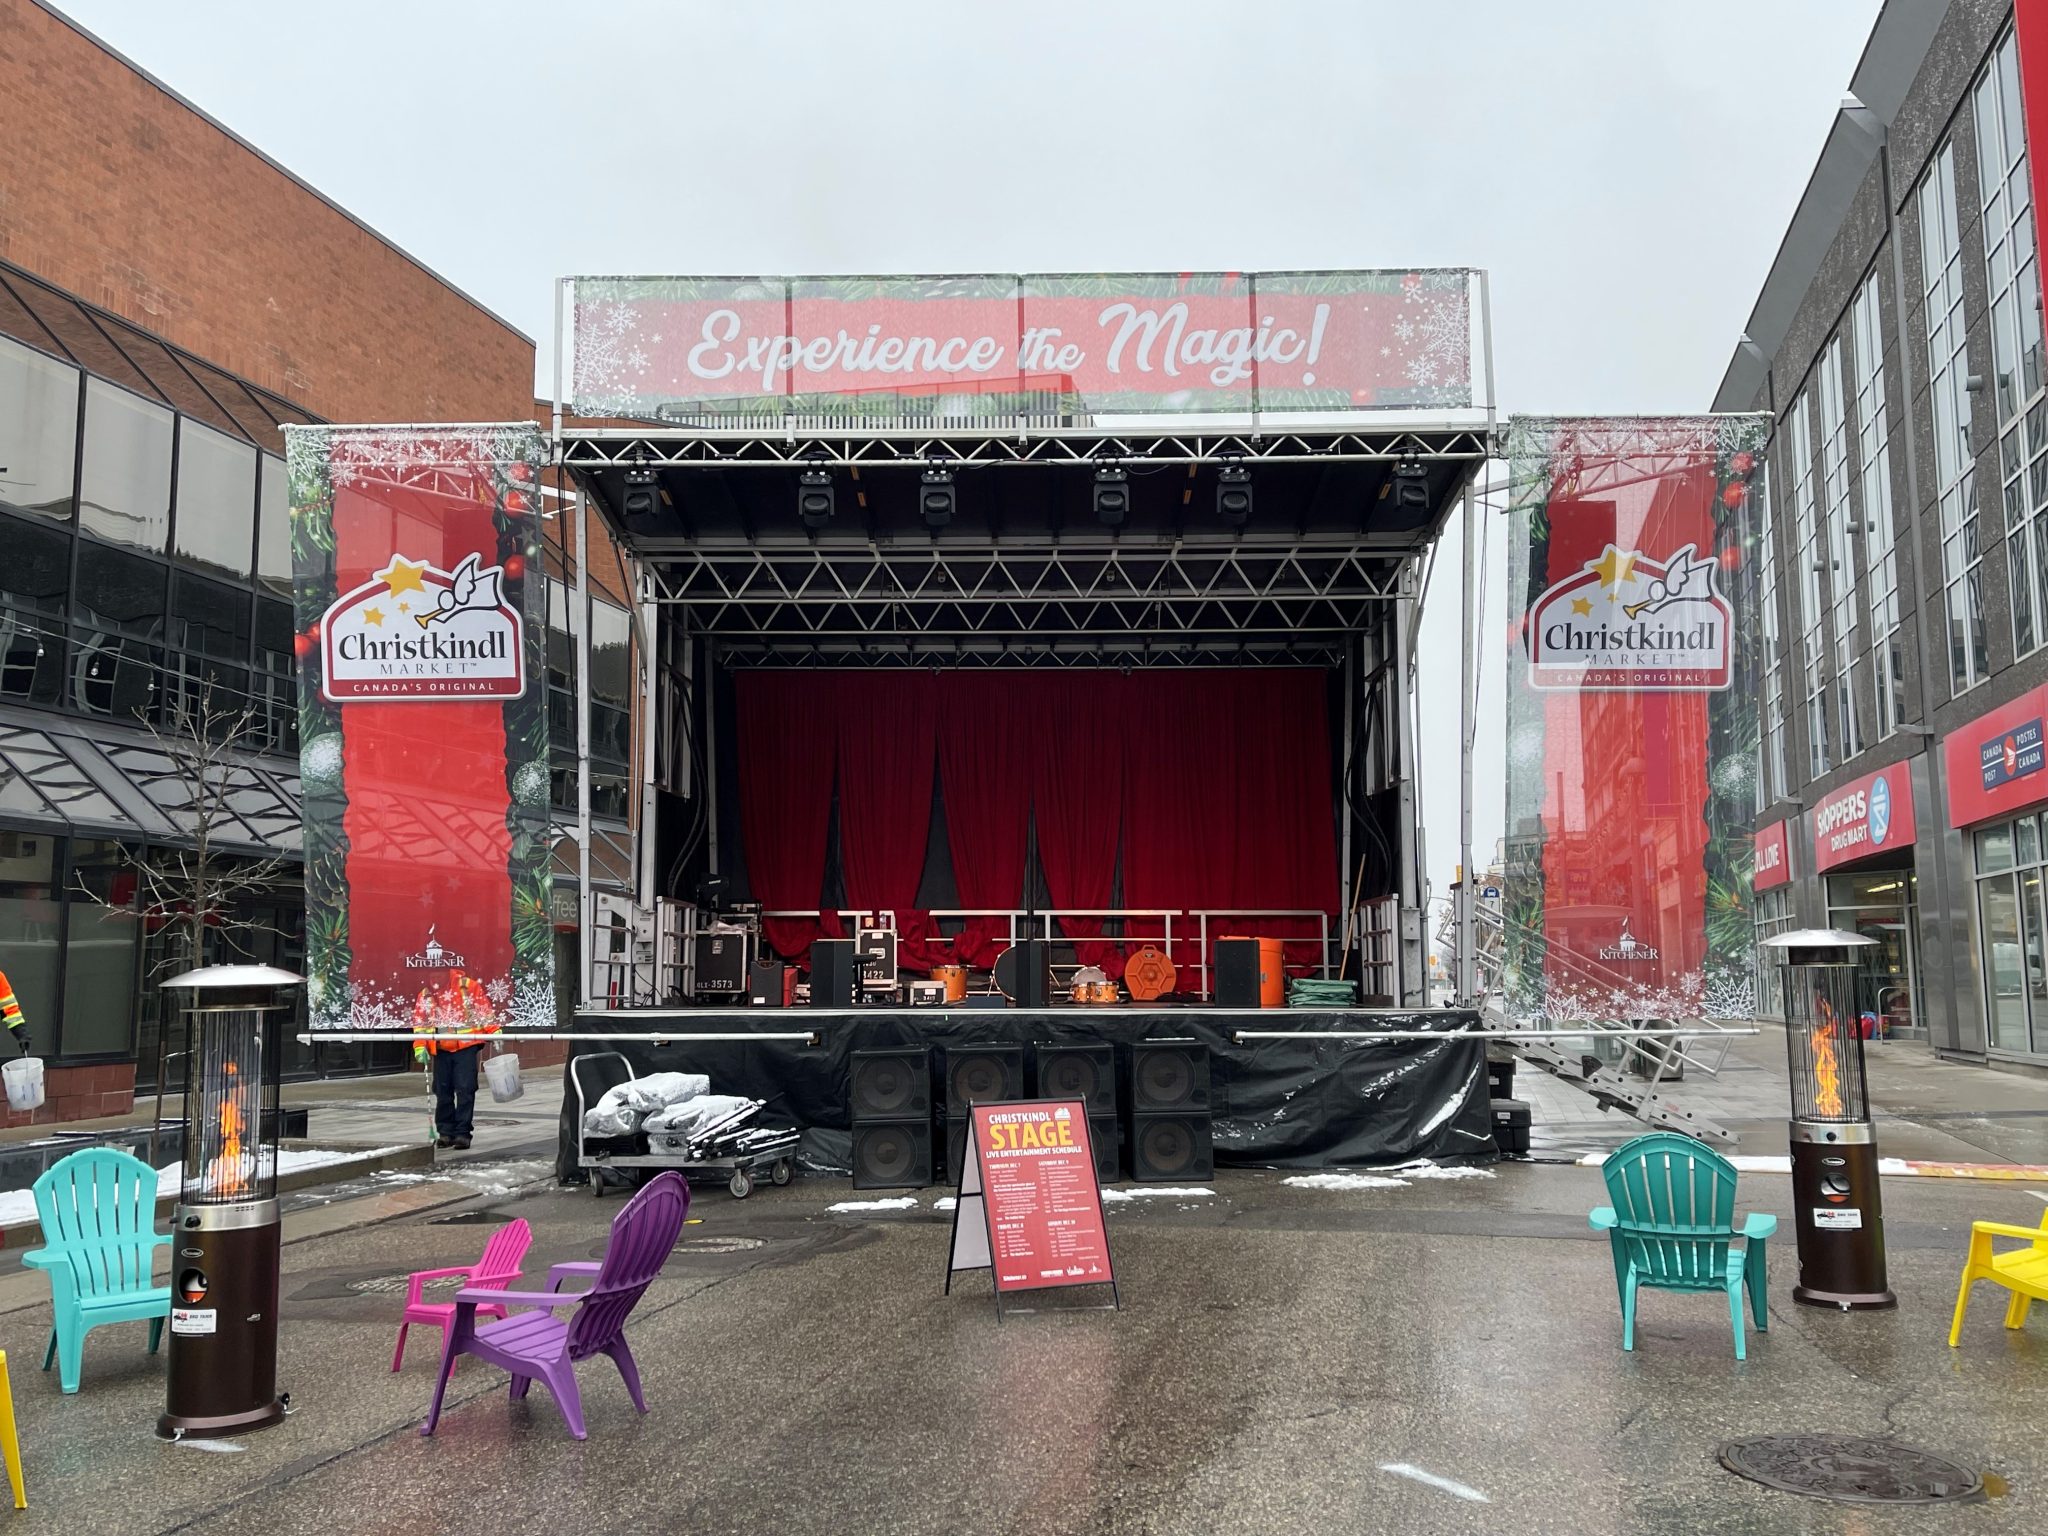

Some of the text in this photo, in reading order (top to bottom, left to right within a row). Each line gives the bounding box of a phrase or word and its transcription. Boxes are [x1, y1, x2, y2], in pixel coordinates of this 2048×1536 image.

[687, 302, 1331, 391] Experience the Magic!
[1545, 622, 1716, 650] Christkindl
[339, 631, 508, 660] Christkindl
[1557, 671, 1701, 682] CANADA'S ORIGINAL
[353, 682, 495, 692] CANADA'S ORIGINAL
[2016, 728, 2037, 746] POSTES
[1983, 743, 2003, 761] CANADA
[2018, 751, 2041, 769] CANADA
[1984, 769, 1996, 783] POST
[1817, 791, 1867, 837] SHOPPERS
[1831, 824, 1868, 852] DRUG MART
[406, 955, 465, 968] KITCHENER
[1600, 948, 1659, 960] KITCHENER
[988, 1112, 1052, 1124] CHRISTKINDL
[989, 1120, 1074, 1150] STAGE
[986, 1145, 1083, 1158] LIVE ENTERTAINMENT SCHEDULE
